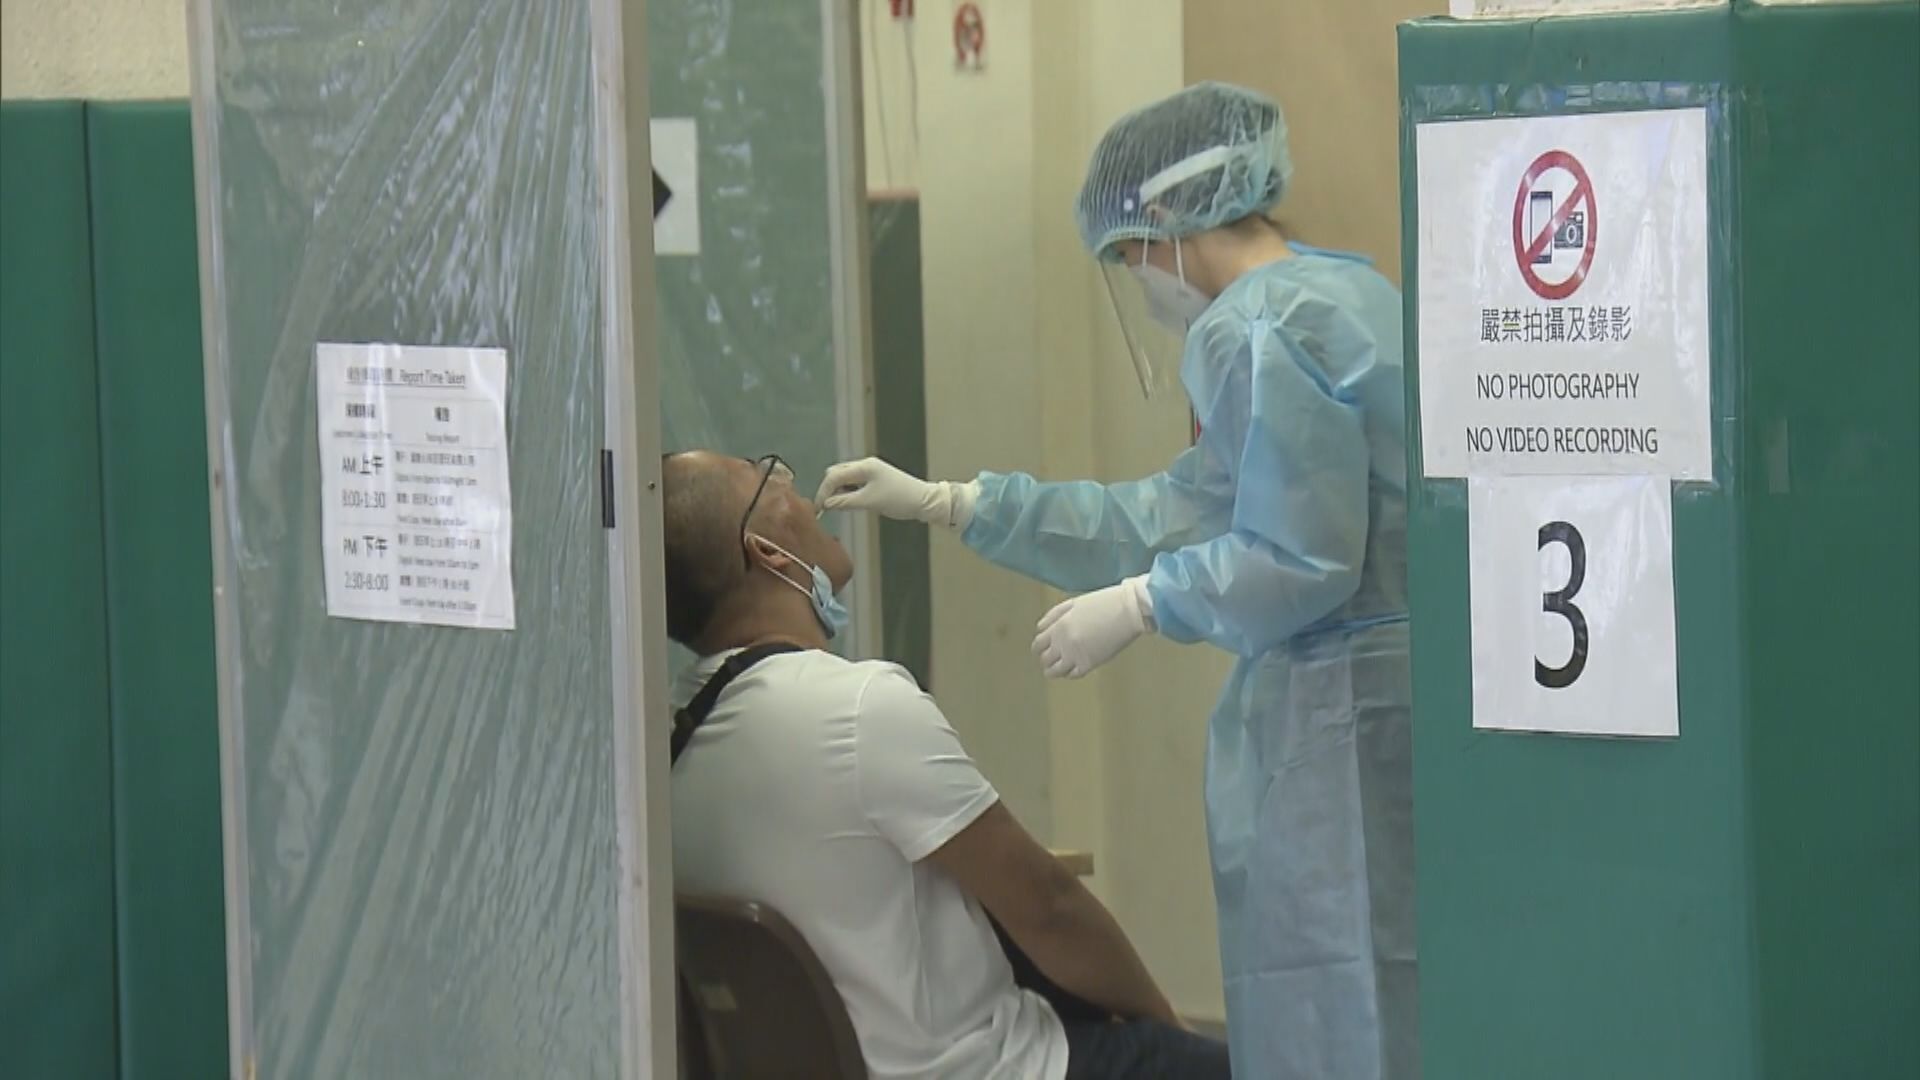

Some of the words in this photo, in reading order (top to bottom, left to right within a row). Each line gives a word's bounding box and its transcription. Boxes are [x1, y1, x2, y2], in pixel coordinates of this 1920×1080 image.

[1480, 305, 1632, 343] 嚴禁拍攝及錄影
[400, 369, 424, 385] Report
[425, 369, 443, 384] Time
[444, 370, 466, 385] Taken
[1477, 373, 1504, 399] NO
[1509, 373, 1640, 399] PHOTOGRAPHY
[1466, 426, 1493, 453] NO
[1497, 426, 1549, 453] VIDEO
[1554, 427, 1658, 454] RECORDING
[342, 456, 356, 474] AM
[359, 453, 384, 475] 上午
[343, 536, 358, 556] PM
[362, 534, 388, 558] 下午
[1535, 521, 1588, 688] 3
